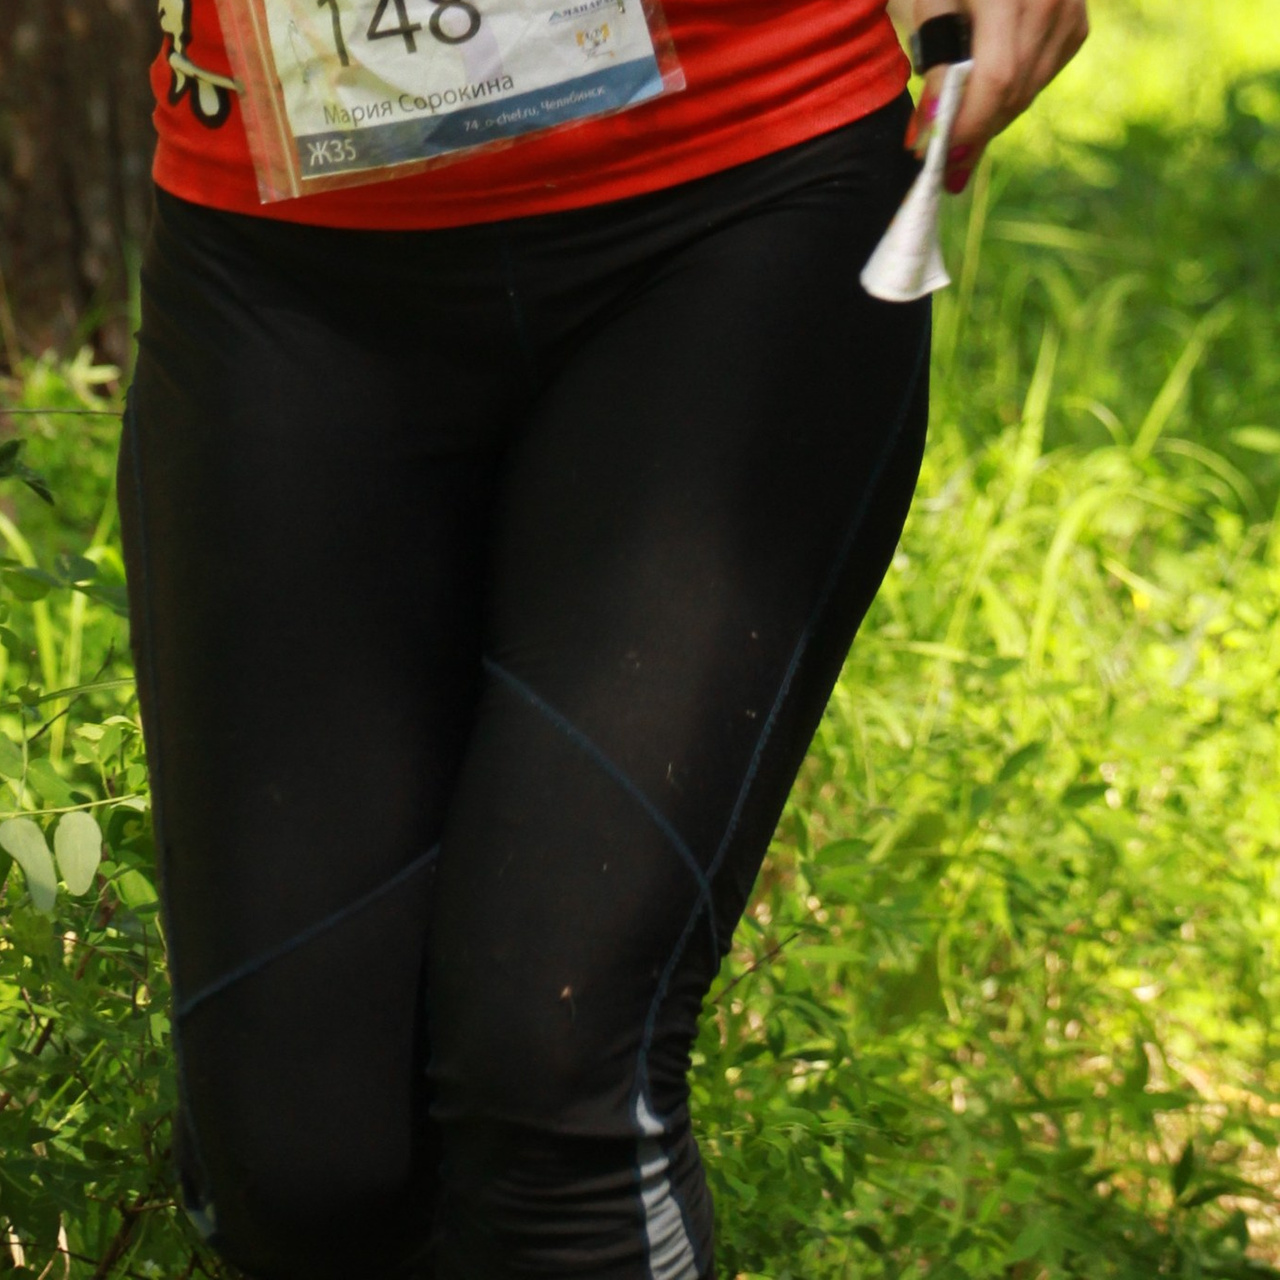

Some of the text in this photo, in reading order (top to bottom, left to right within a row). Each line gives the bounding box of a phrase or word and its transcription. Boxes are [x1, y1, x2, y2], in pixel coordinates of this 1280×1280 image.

[323, 73, 515, 126] Мария Сорокина
[306, 138, 357, 167] Ж35
